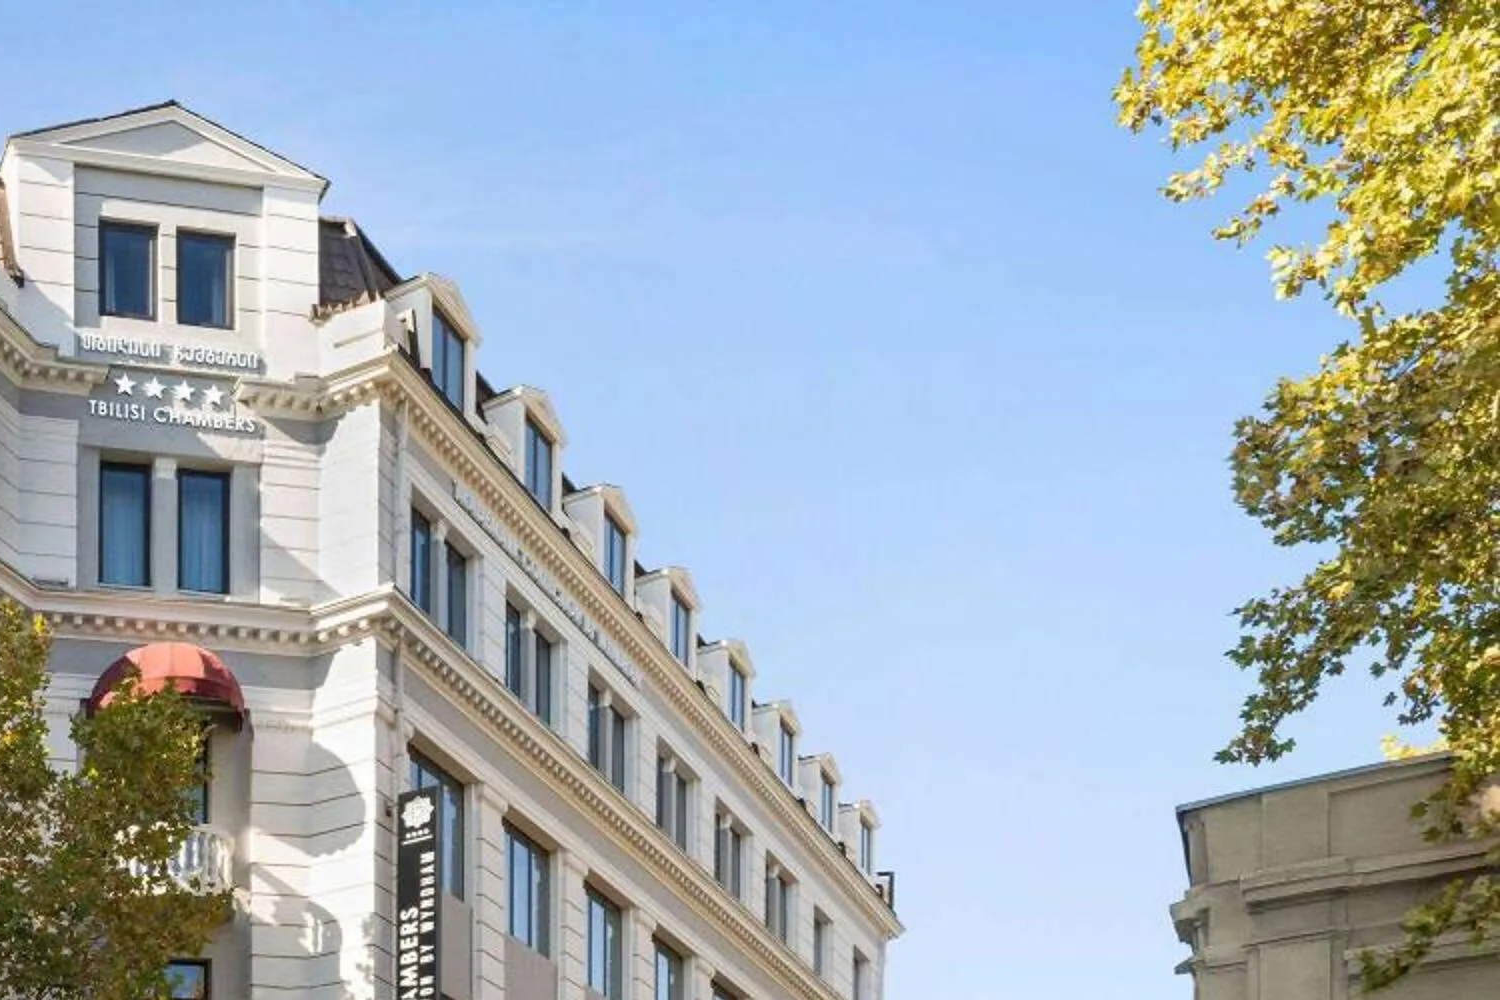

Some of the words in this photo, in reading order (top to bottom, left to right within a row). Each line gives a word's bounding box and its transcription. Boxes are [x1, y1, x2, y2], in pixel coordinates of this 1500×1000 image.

[88, 399, 146, 421] TBILISI
[153, 405, 257, 432] CHAMBERS
[419, 851, 435, 934] WYNDHAM
[419, 944, 435, 965] BY
